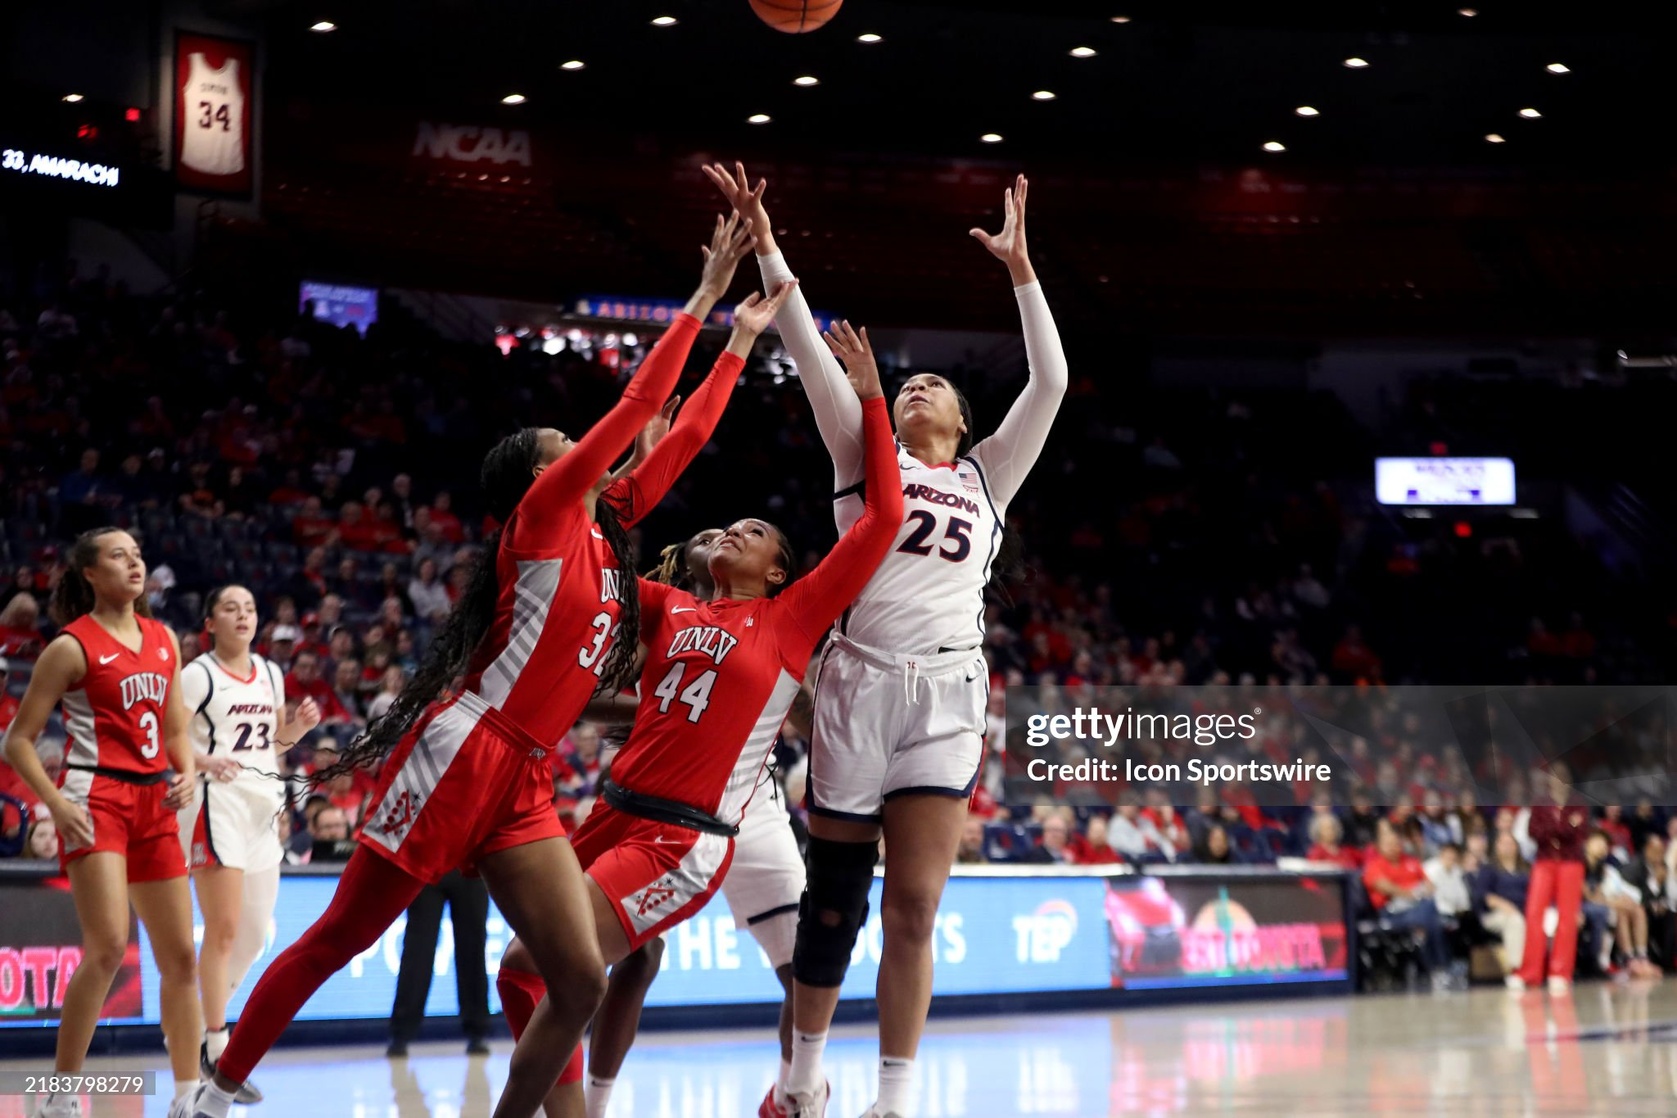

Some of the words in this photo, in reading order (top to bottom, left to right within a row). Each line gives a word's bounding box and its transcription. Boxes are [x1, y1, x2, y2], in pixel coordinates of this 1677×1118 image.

[198, 101, 230, 132] 34
[413, 121, 532, 167] NCAA
[902, 483, 980, 519] ARIZONA
[895, 509, 974, 564] 25
[666, 626, 739, 666] UNLV
[119, 671, 168, 712] UNLV
[653, 660, 719, 724] 44
[139, 710, 160, 760] 3
[231, 721, 270, 754] 23
[1012, 915, 1073, 964] TEP
